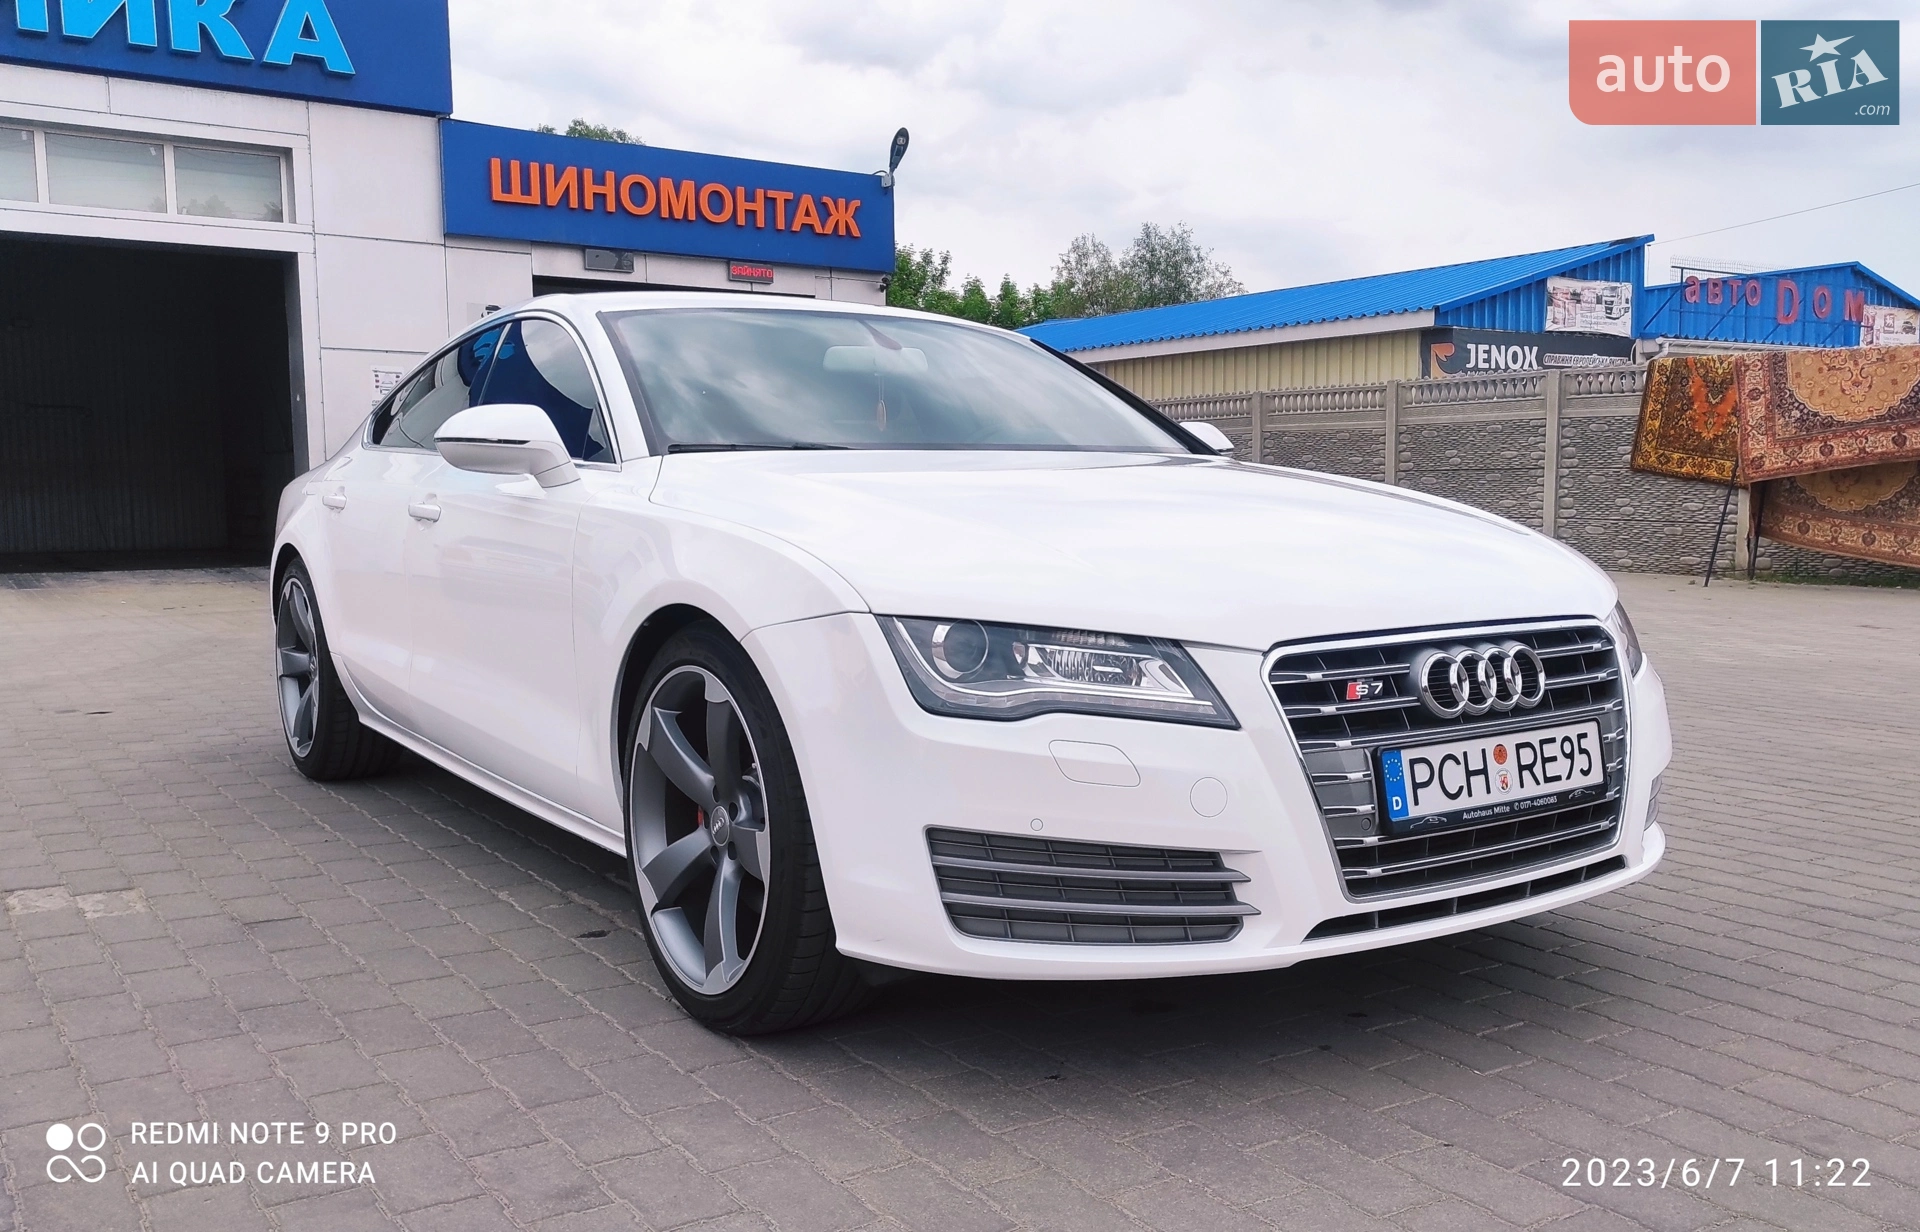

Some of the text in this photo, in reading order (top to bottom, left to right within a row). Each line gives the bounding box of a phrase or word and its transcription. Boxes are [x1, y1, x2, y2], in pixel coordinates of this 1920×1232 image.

[489, 157, 862, 238] ШИНОМОНТАЖ
[731, 265, 773, 278] ЗАЙНЯТО
[1465, 343, 1539, 370] JENOX
[1355, 682, 1383, 696] S7
[1392, 732, 1593, 811] D PCH RE95
[1463, 809, 1493, 820] Autohaus
[1493, 805, 1511, 814] Mitte
